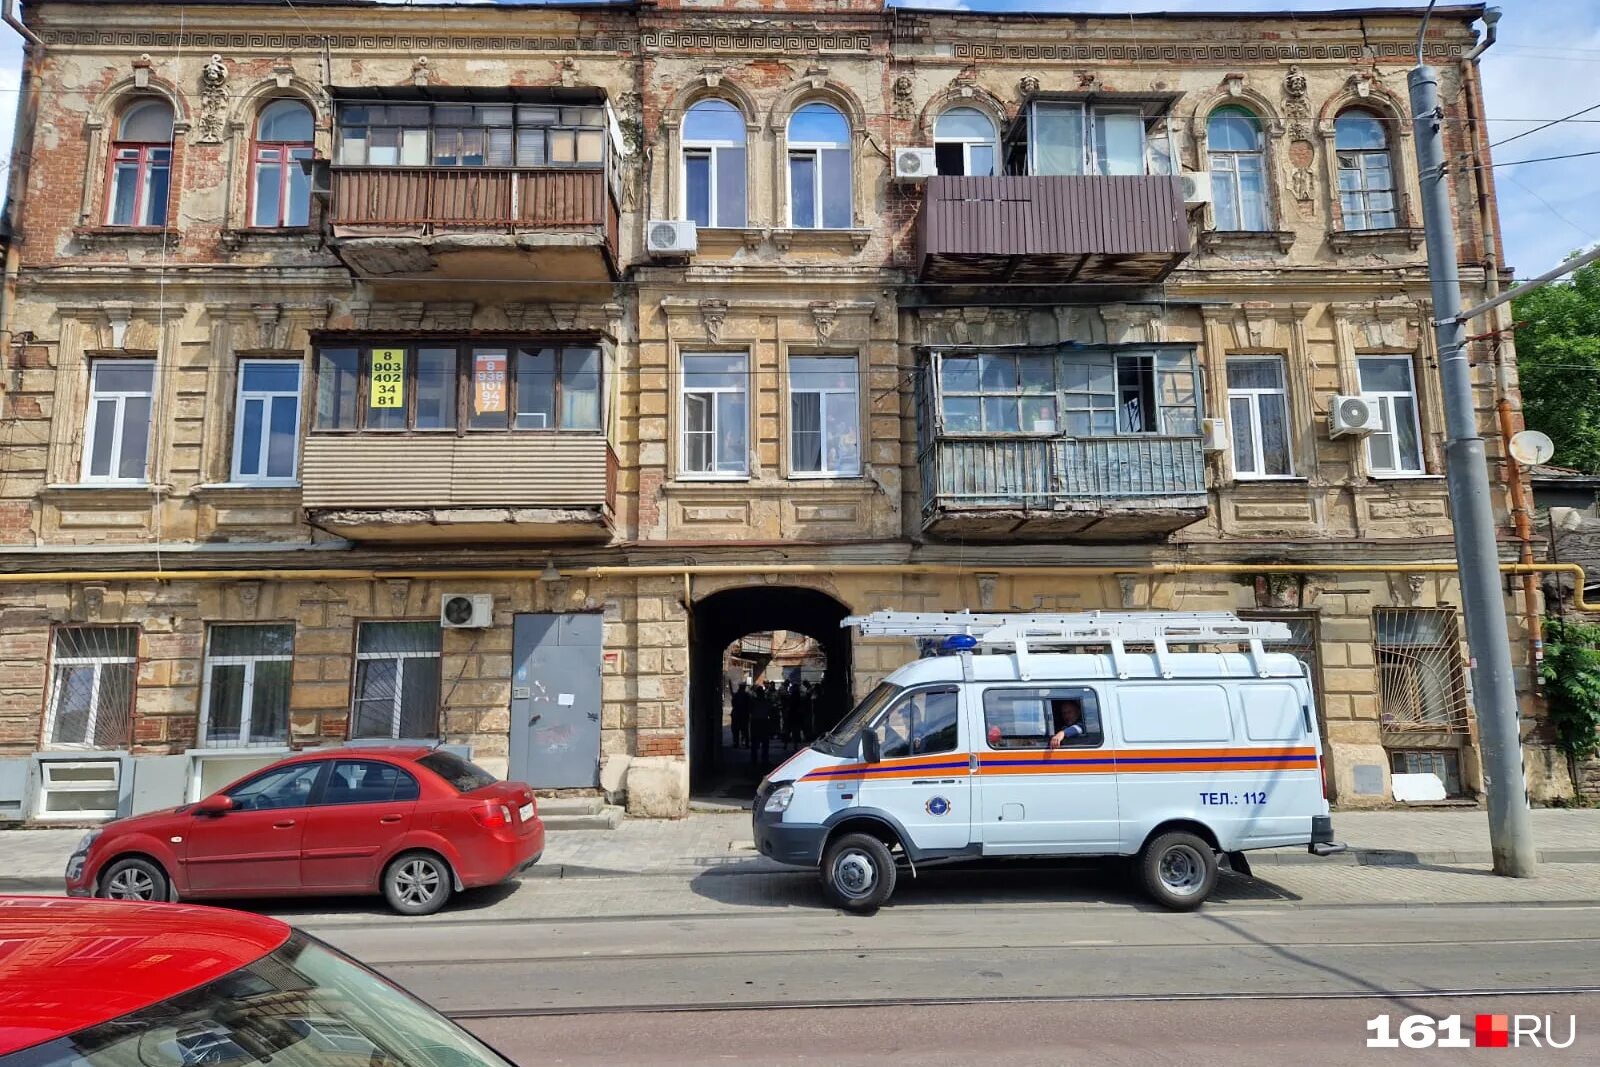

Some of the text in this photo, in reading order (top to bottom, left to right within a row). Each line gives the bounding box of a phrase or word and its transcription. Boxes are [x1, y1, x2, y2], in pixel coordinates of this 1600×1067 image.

[383, 351, 392, 360] 8
[374, 362, 401, 371] 903
[486, 361, 496, 371] 8
[374, 373, 401, 382] 402
[378, 384, 396, 393] 34
[482, 391, 500, 400] 94
[378, 396, 395, 405] 81
[1200, 792, 1267, 805] ТЕЛ.: 112
